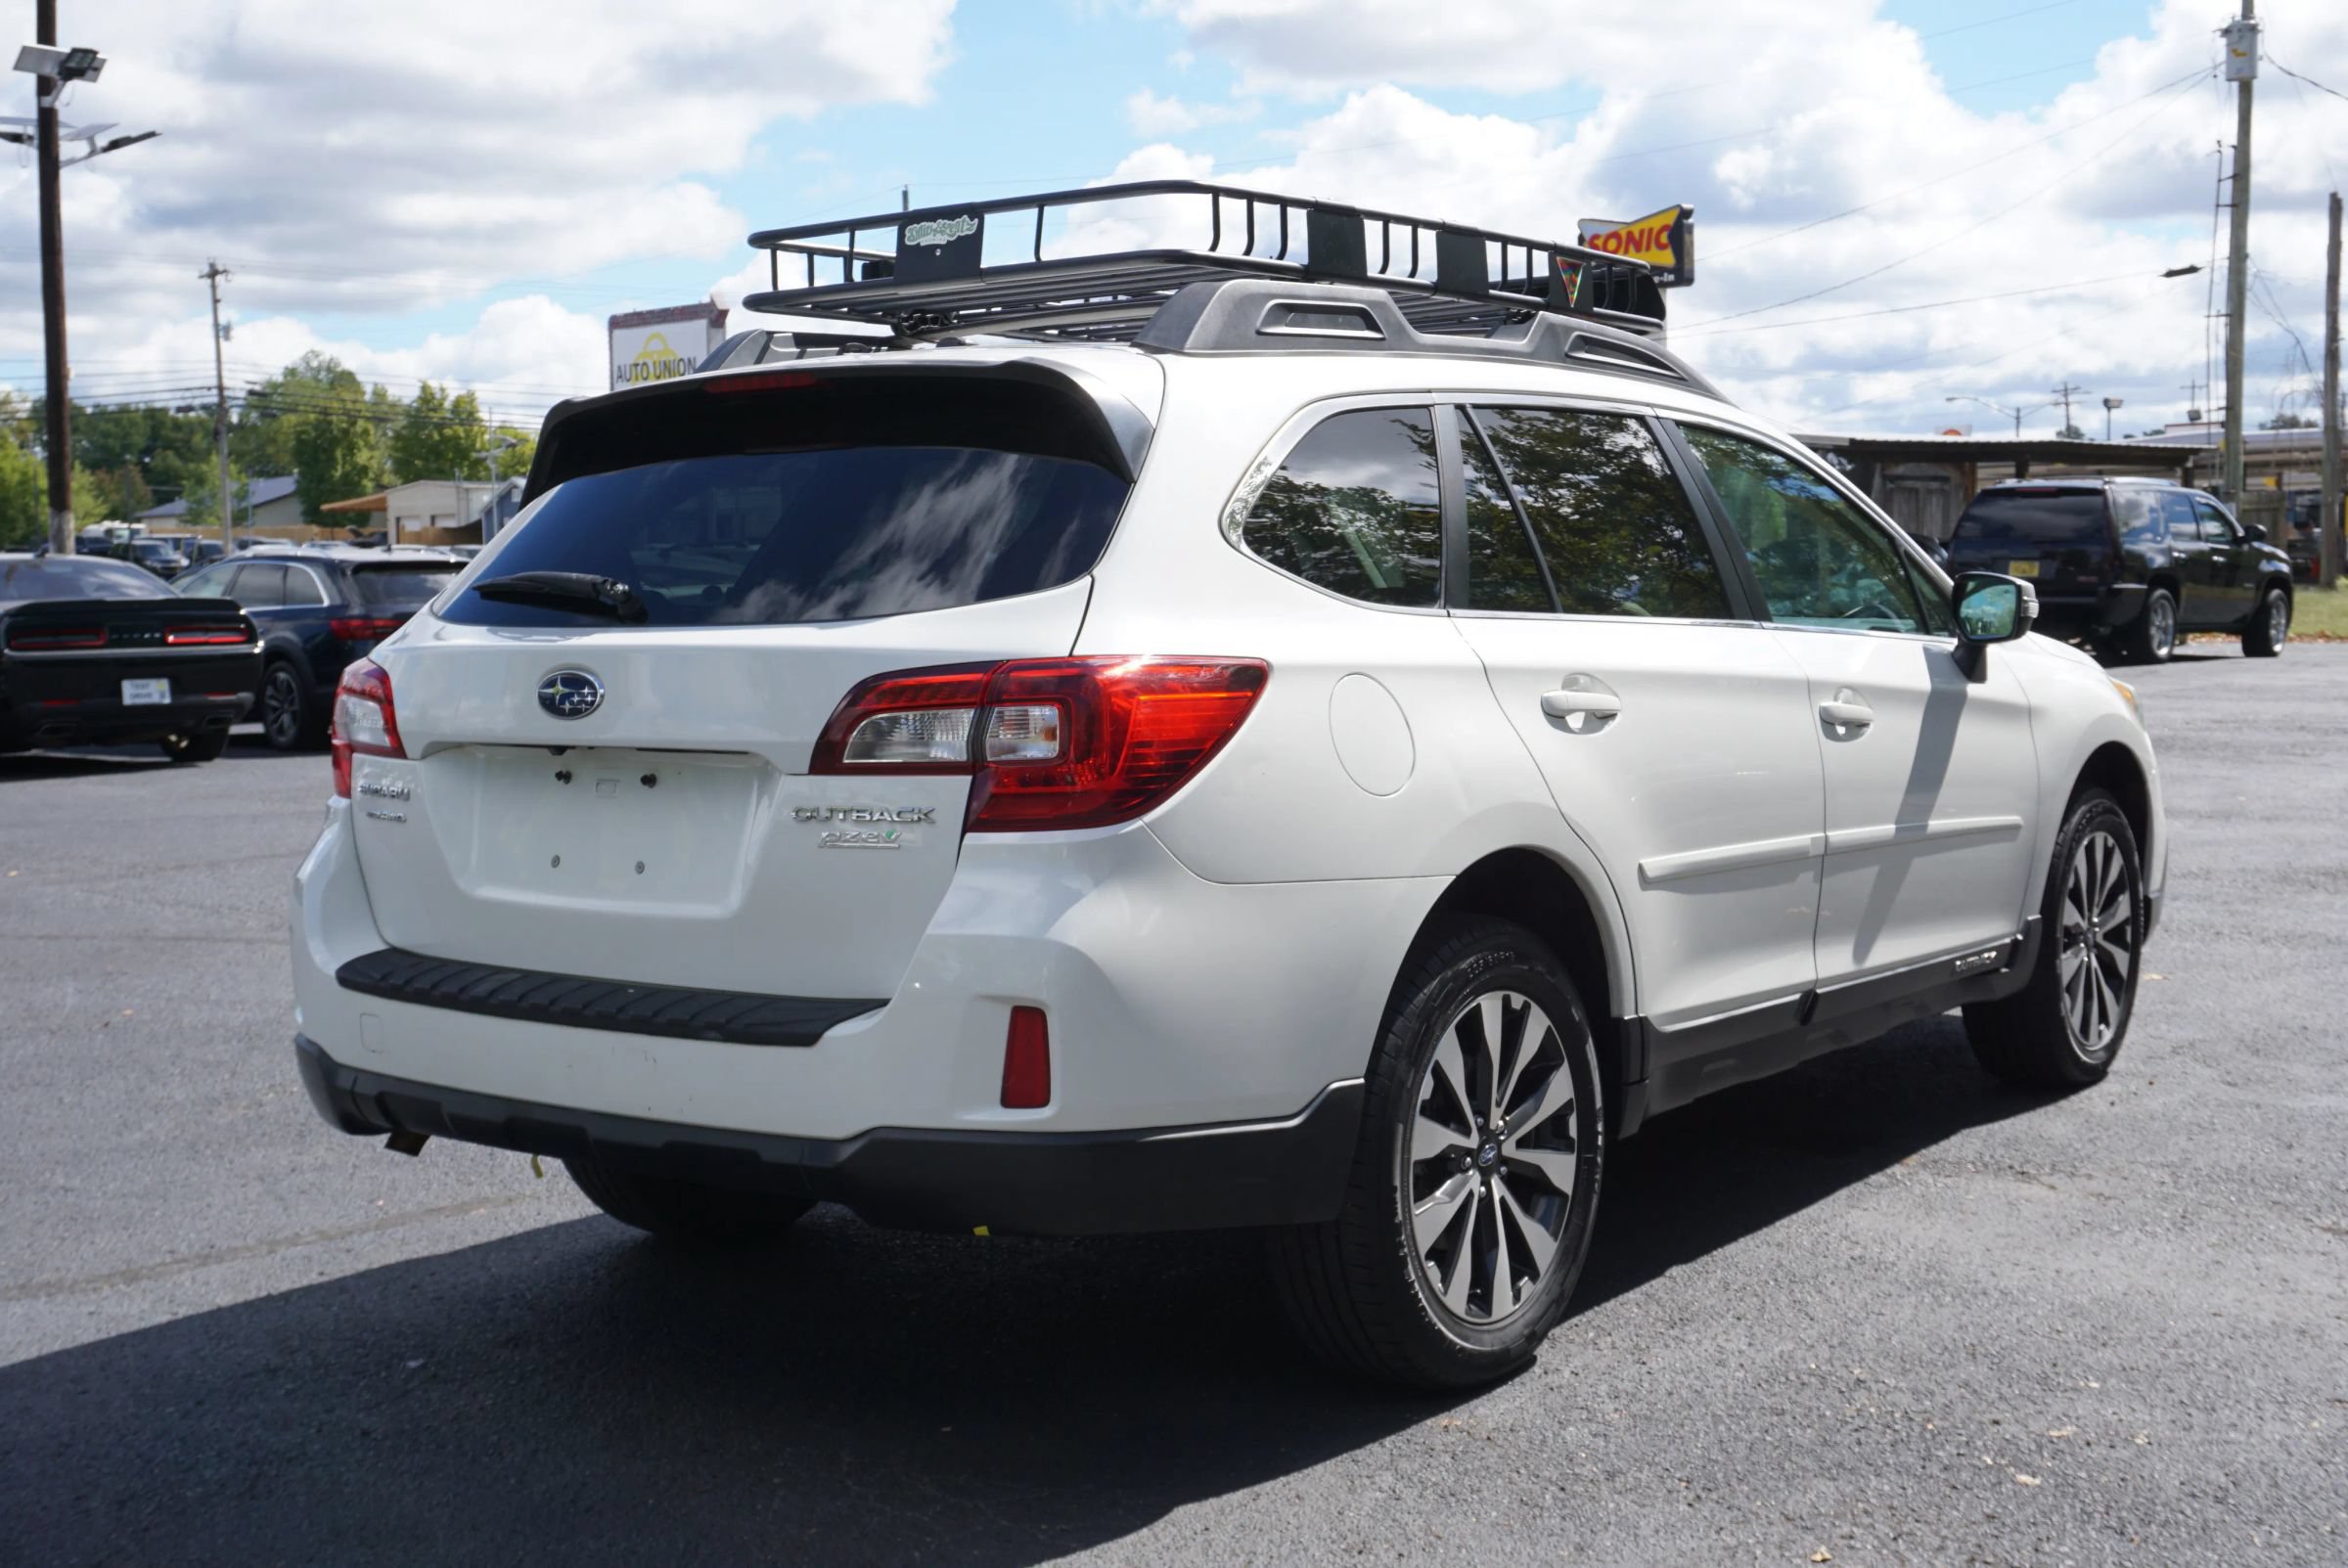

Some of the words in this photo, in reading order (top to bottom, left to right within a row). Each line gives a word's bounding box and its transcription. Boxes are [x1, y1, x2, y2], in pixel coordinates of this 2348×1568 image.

[1587, 223, 1672, 254] SONIC
[616, 362, 650, 383] AUTO
[654, 356, 697, 379] UNION
[790, 806, 936, 824] OUTBACK
